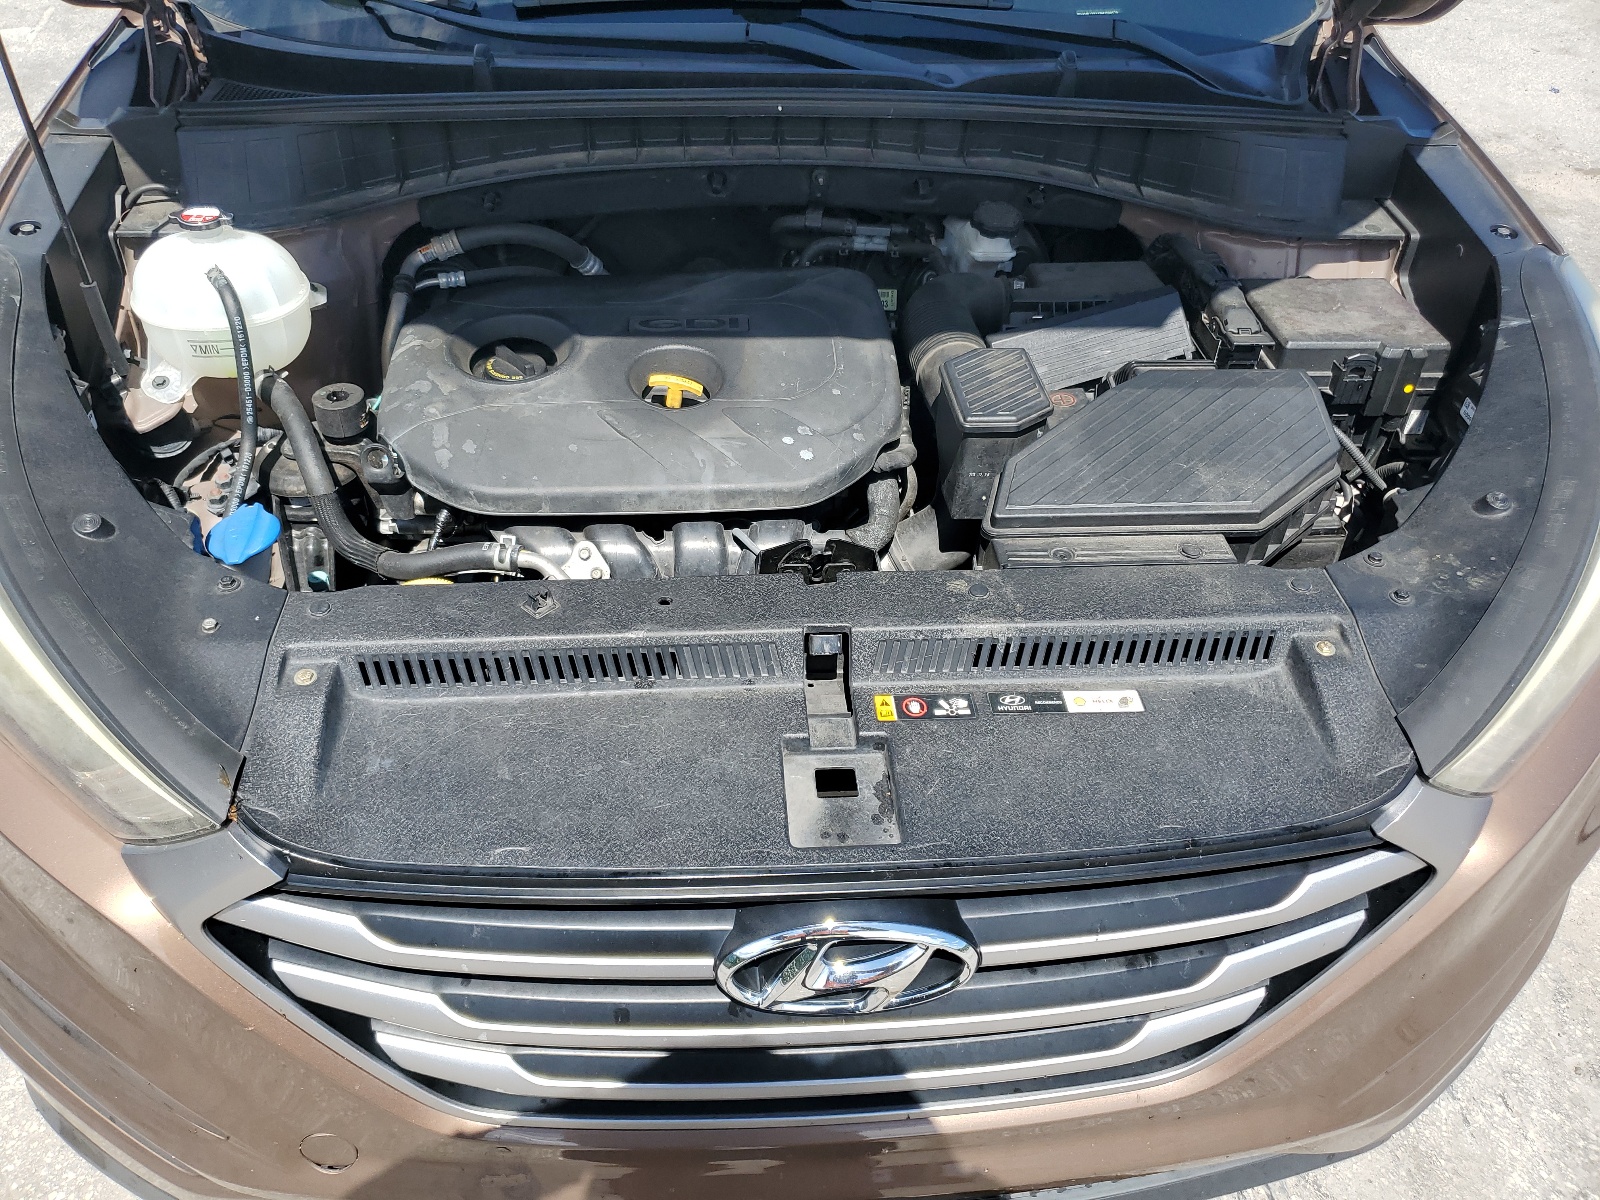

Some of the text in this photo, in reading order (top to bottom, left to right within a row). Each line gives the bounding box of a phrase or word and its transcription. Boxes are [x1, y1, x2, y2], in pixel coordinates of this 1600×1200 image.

[234, 316, 245, 341] 161220
[639, 317, 739, 328] GDI
[199, 344, 220, 355] MIN
[243, 371, 254, 416] 25451-D3000
